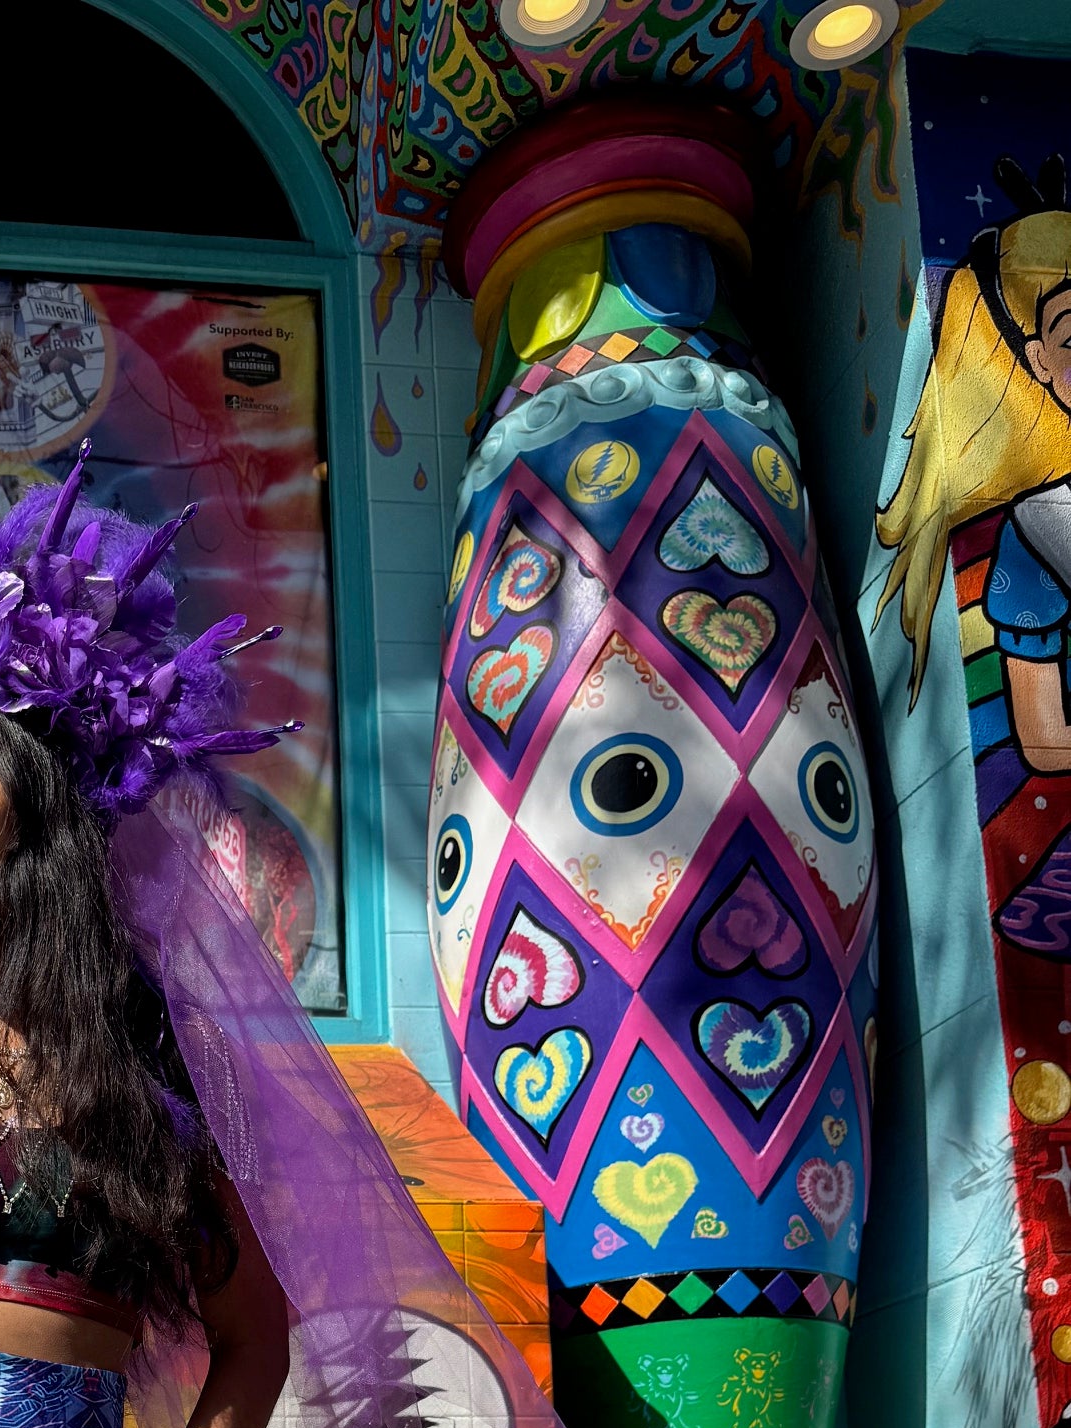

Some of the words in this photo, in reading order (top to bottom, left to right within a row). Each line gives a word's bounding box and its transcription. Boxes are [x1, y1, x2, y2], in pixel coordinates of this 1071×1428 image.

[33, 302, 79, 320] HAIGHT
[209, 323, 273, 337] Supported
[276, 328, 295, 341] By:
